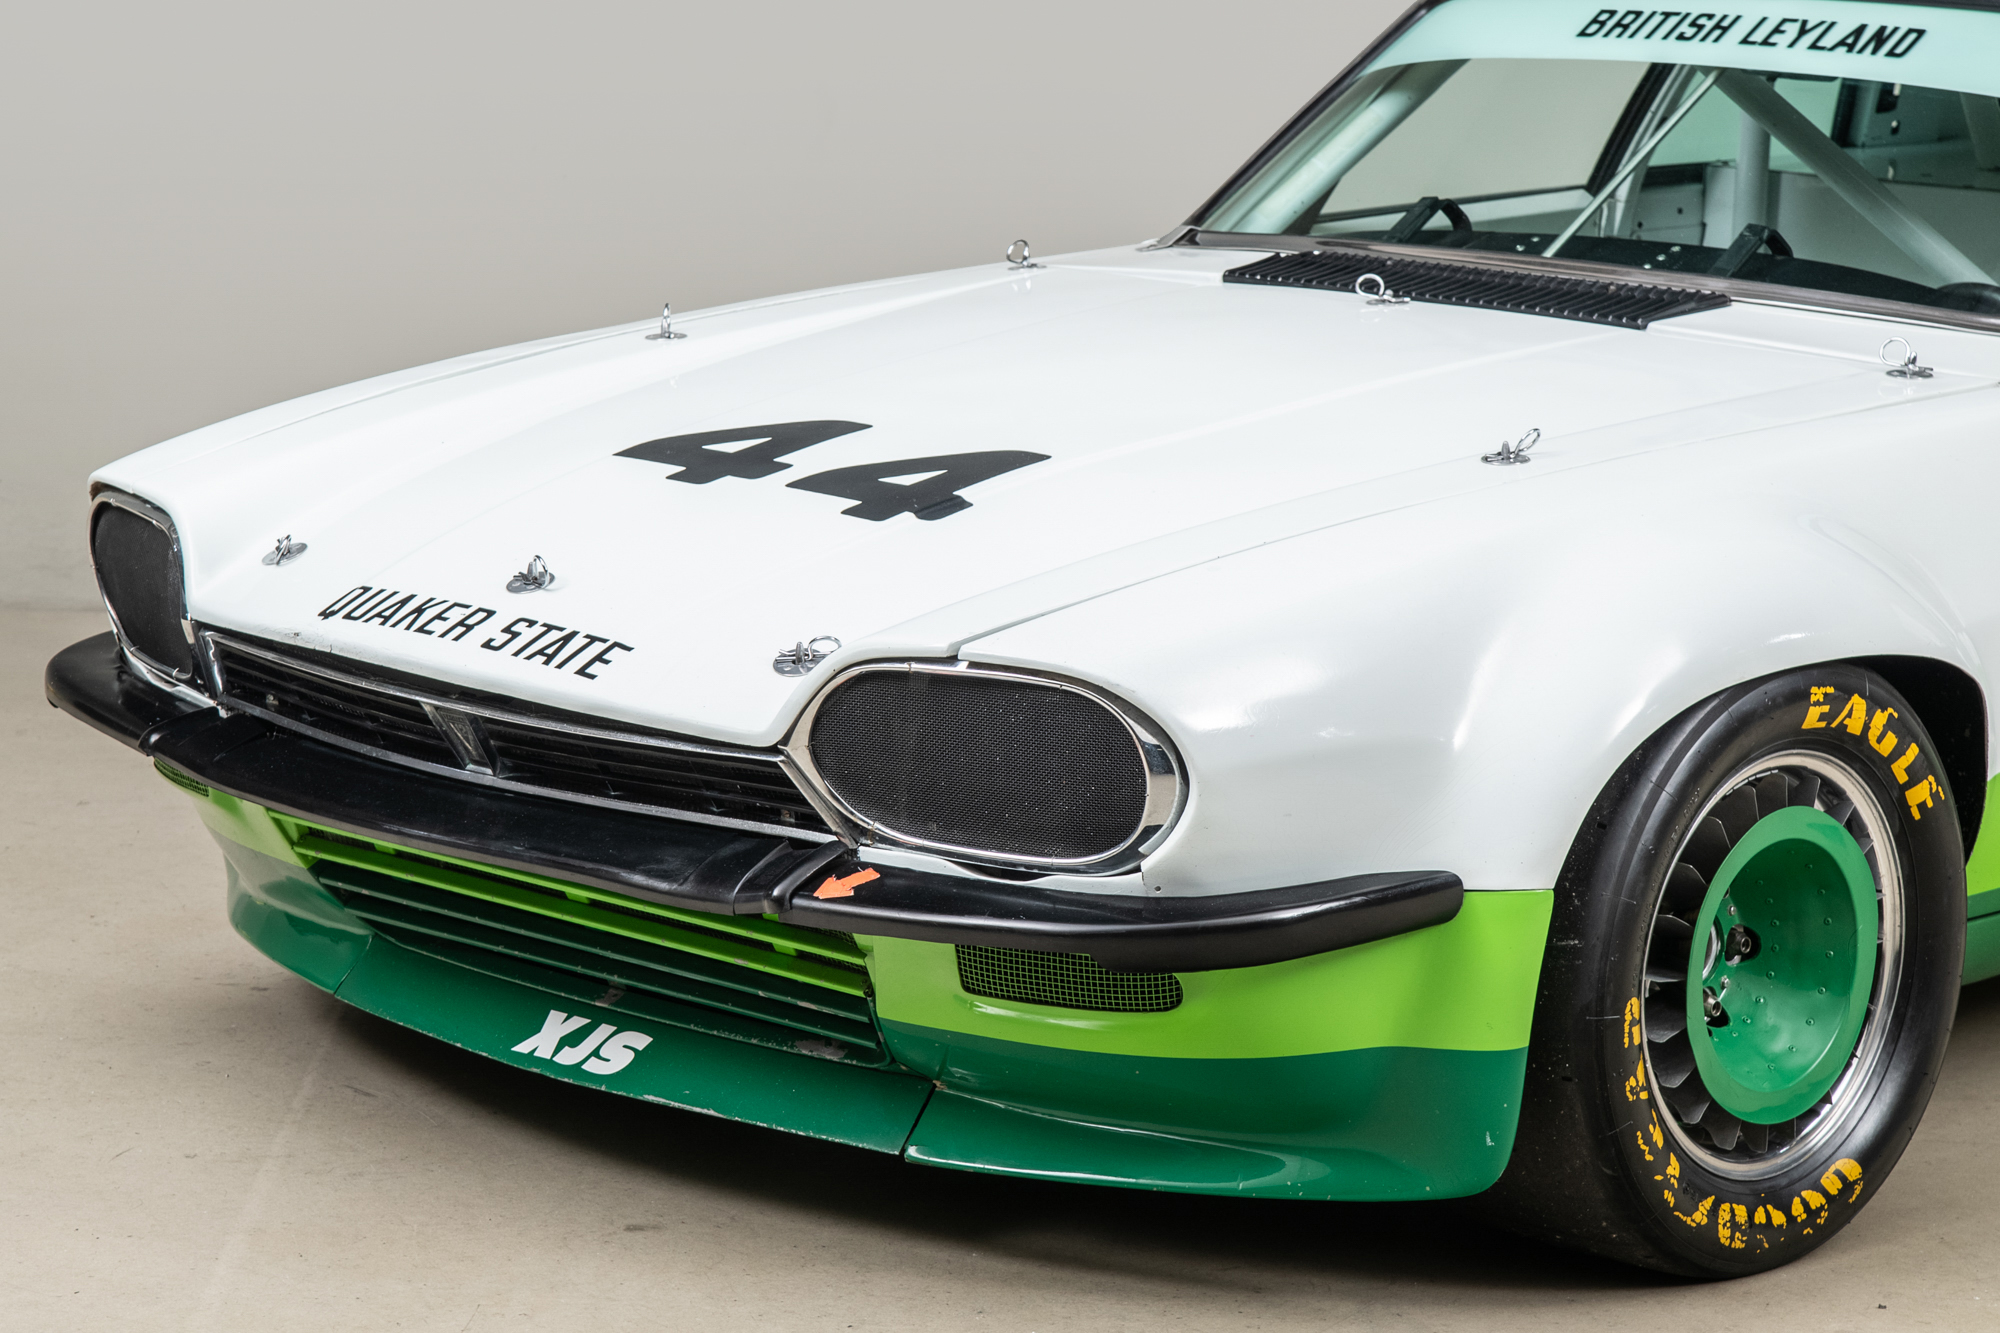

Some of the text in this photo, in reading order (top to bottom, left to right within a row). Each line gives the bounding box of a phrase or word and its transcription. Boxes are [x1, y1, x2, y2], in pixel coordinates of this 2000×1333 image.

[1576, 9, 1926, 58] BRITISH LEYLAND
[612, 420, 1052, 521] 44
[317, 585, 635, 681] QUAKER STATE
[1801, 686, 1945, 821] EAGLE
[511, 1009, 654, 1075] XJS
